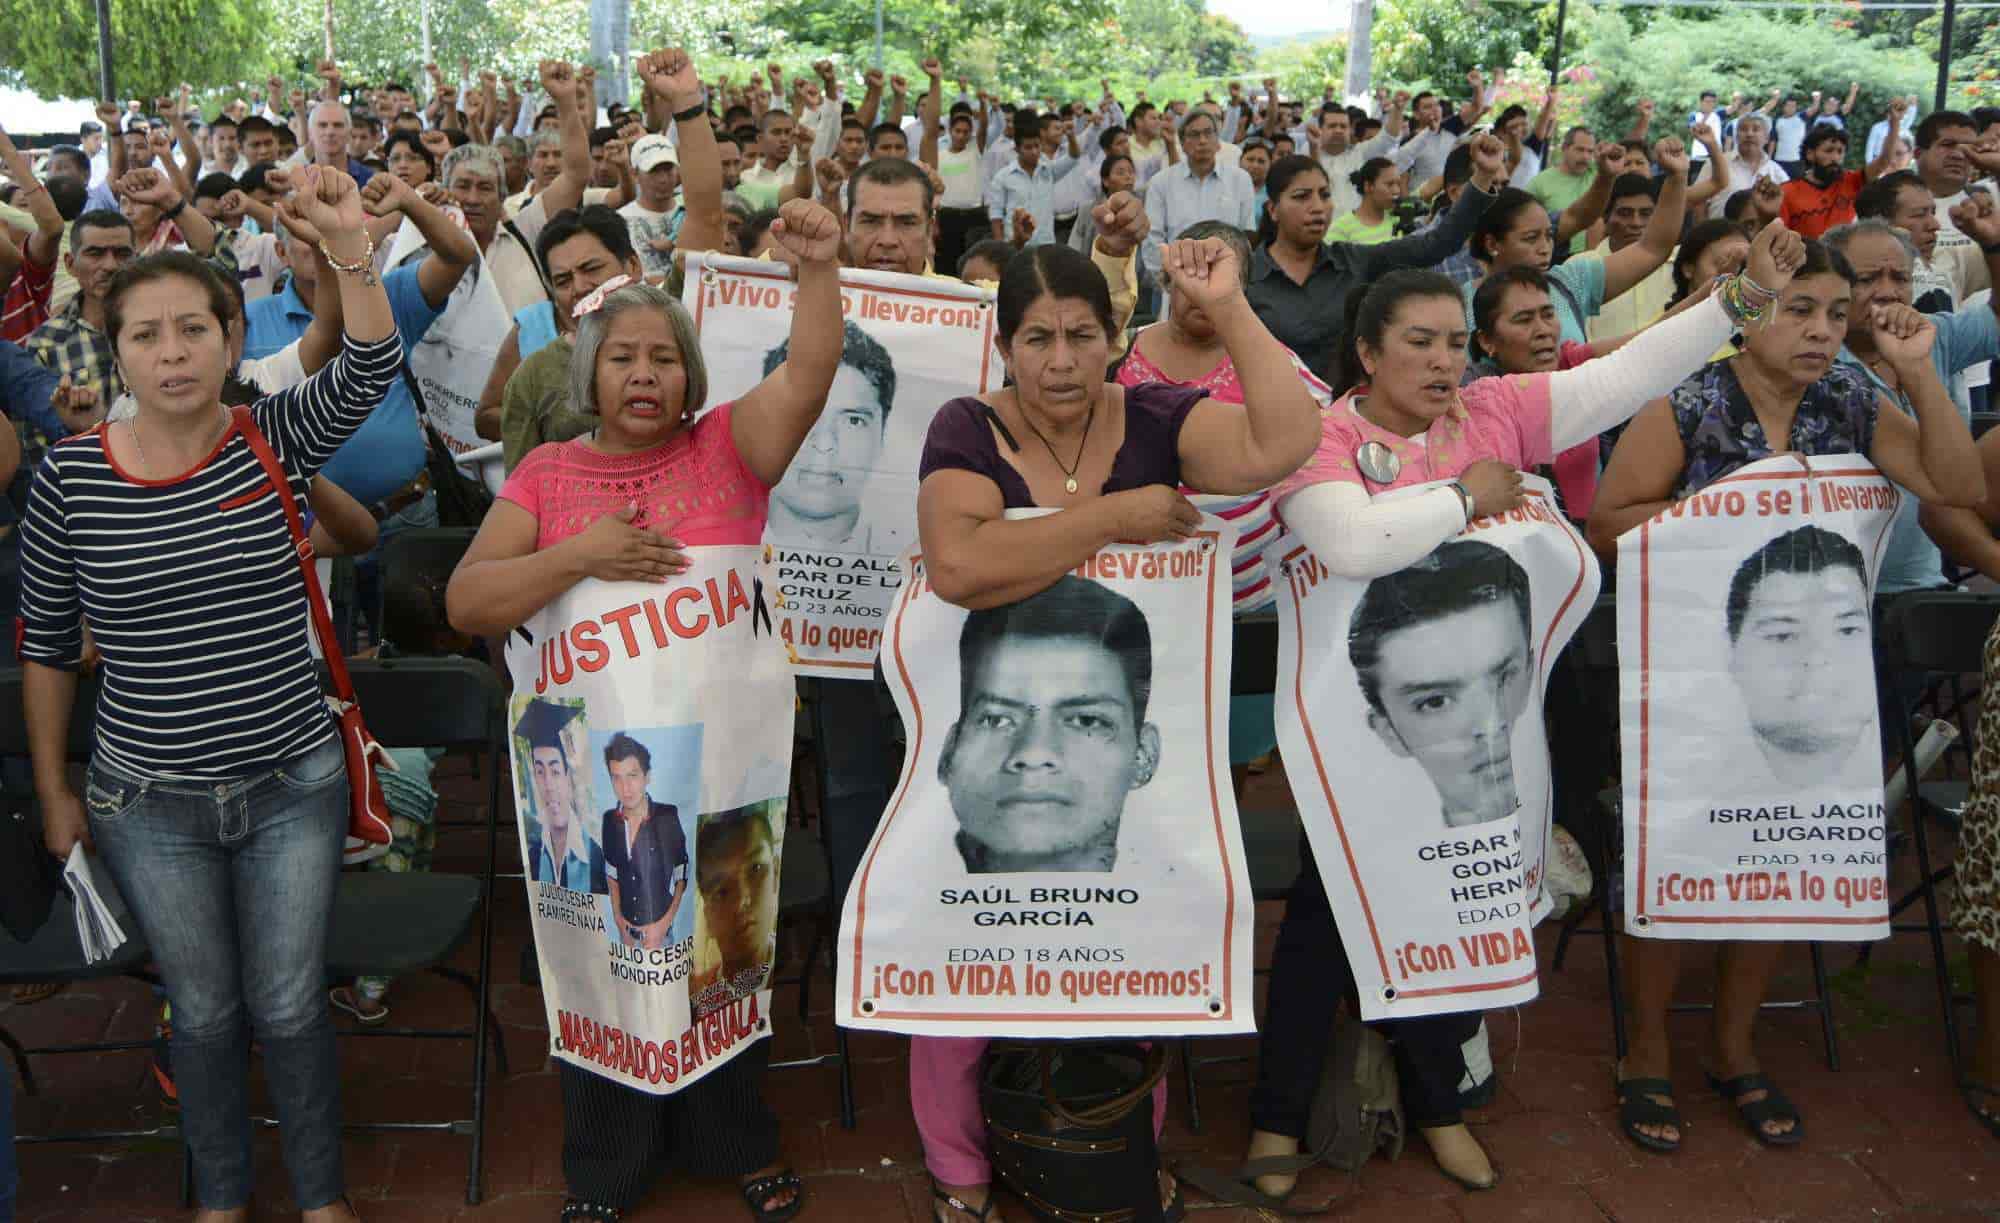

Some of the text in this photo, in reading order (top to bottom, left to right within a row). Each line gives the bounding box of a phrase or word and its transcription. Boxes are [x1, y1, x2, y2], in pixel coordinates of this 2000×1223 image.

[860, 293, 981, 329] llevaron!
[1757, 488, 1793, 517] se
[779, 551, 844, 569] IANO
[778, 567, 828, 584] PAR
[836, 573, 872, 586] DE
[780, 584, 852, 601] CRUZ
[805, 602, 827, 614] 23
[832, 602, 882, 618] AÑOS
[535, 567, 751, 695] JUSTICIA
[801, 618, 822, 647] lo
[827, 625, 884, 654] quer
[1709, 803, 1888, 824] ISRAEL JACIN
[1752, 825, 1886, 843] LUGARDO
[1418, 834, 1508, 861] CÉSAR
[1737, 850, 1888, 866] EDAD 19 AÑO
[1452, 851, 1523, 879] GONZ
[566, 888, 596, 911] CESAR
[939, 885, 1139, 905] SAÚL BRUNO
[1451, 876, 1522, 902] HERN
[1656, 872, 1716, 906] ¡Con
[1725, 871, 1793, 902] VIDA
[1800, 869, 1825, 902] lo
[537, 902, 607, 933] RAMIREZ NAVA
[973, 906, 1095, 927] GARCÍA
[1458, 902, 1521, 925] EDAD
[608, 935, 694, 966] JULIO CESAR
[948, 945, 1125, 963] EDAD 18 AÑOS
[1395, 927, 1532, 980] ¡Con VIDA
[609, 955, 696, 987] MONDRAGON
[873, 963, 1210, 1003] ¡Con VIDA lo queremos!
[557, 1009, 680, 1085] MASACRADOS
[681, 1025, 705, 1077] EN
[700, 993, 760, 1061] IGUALA
